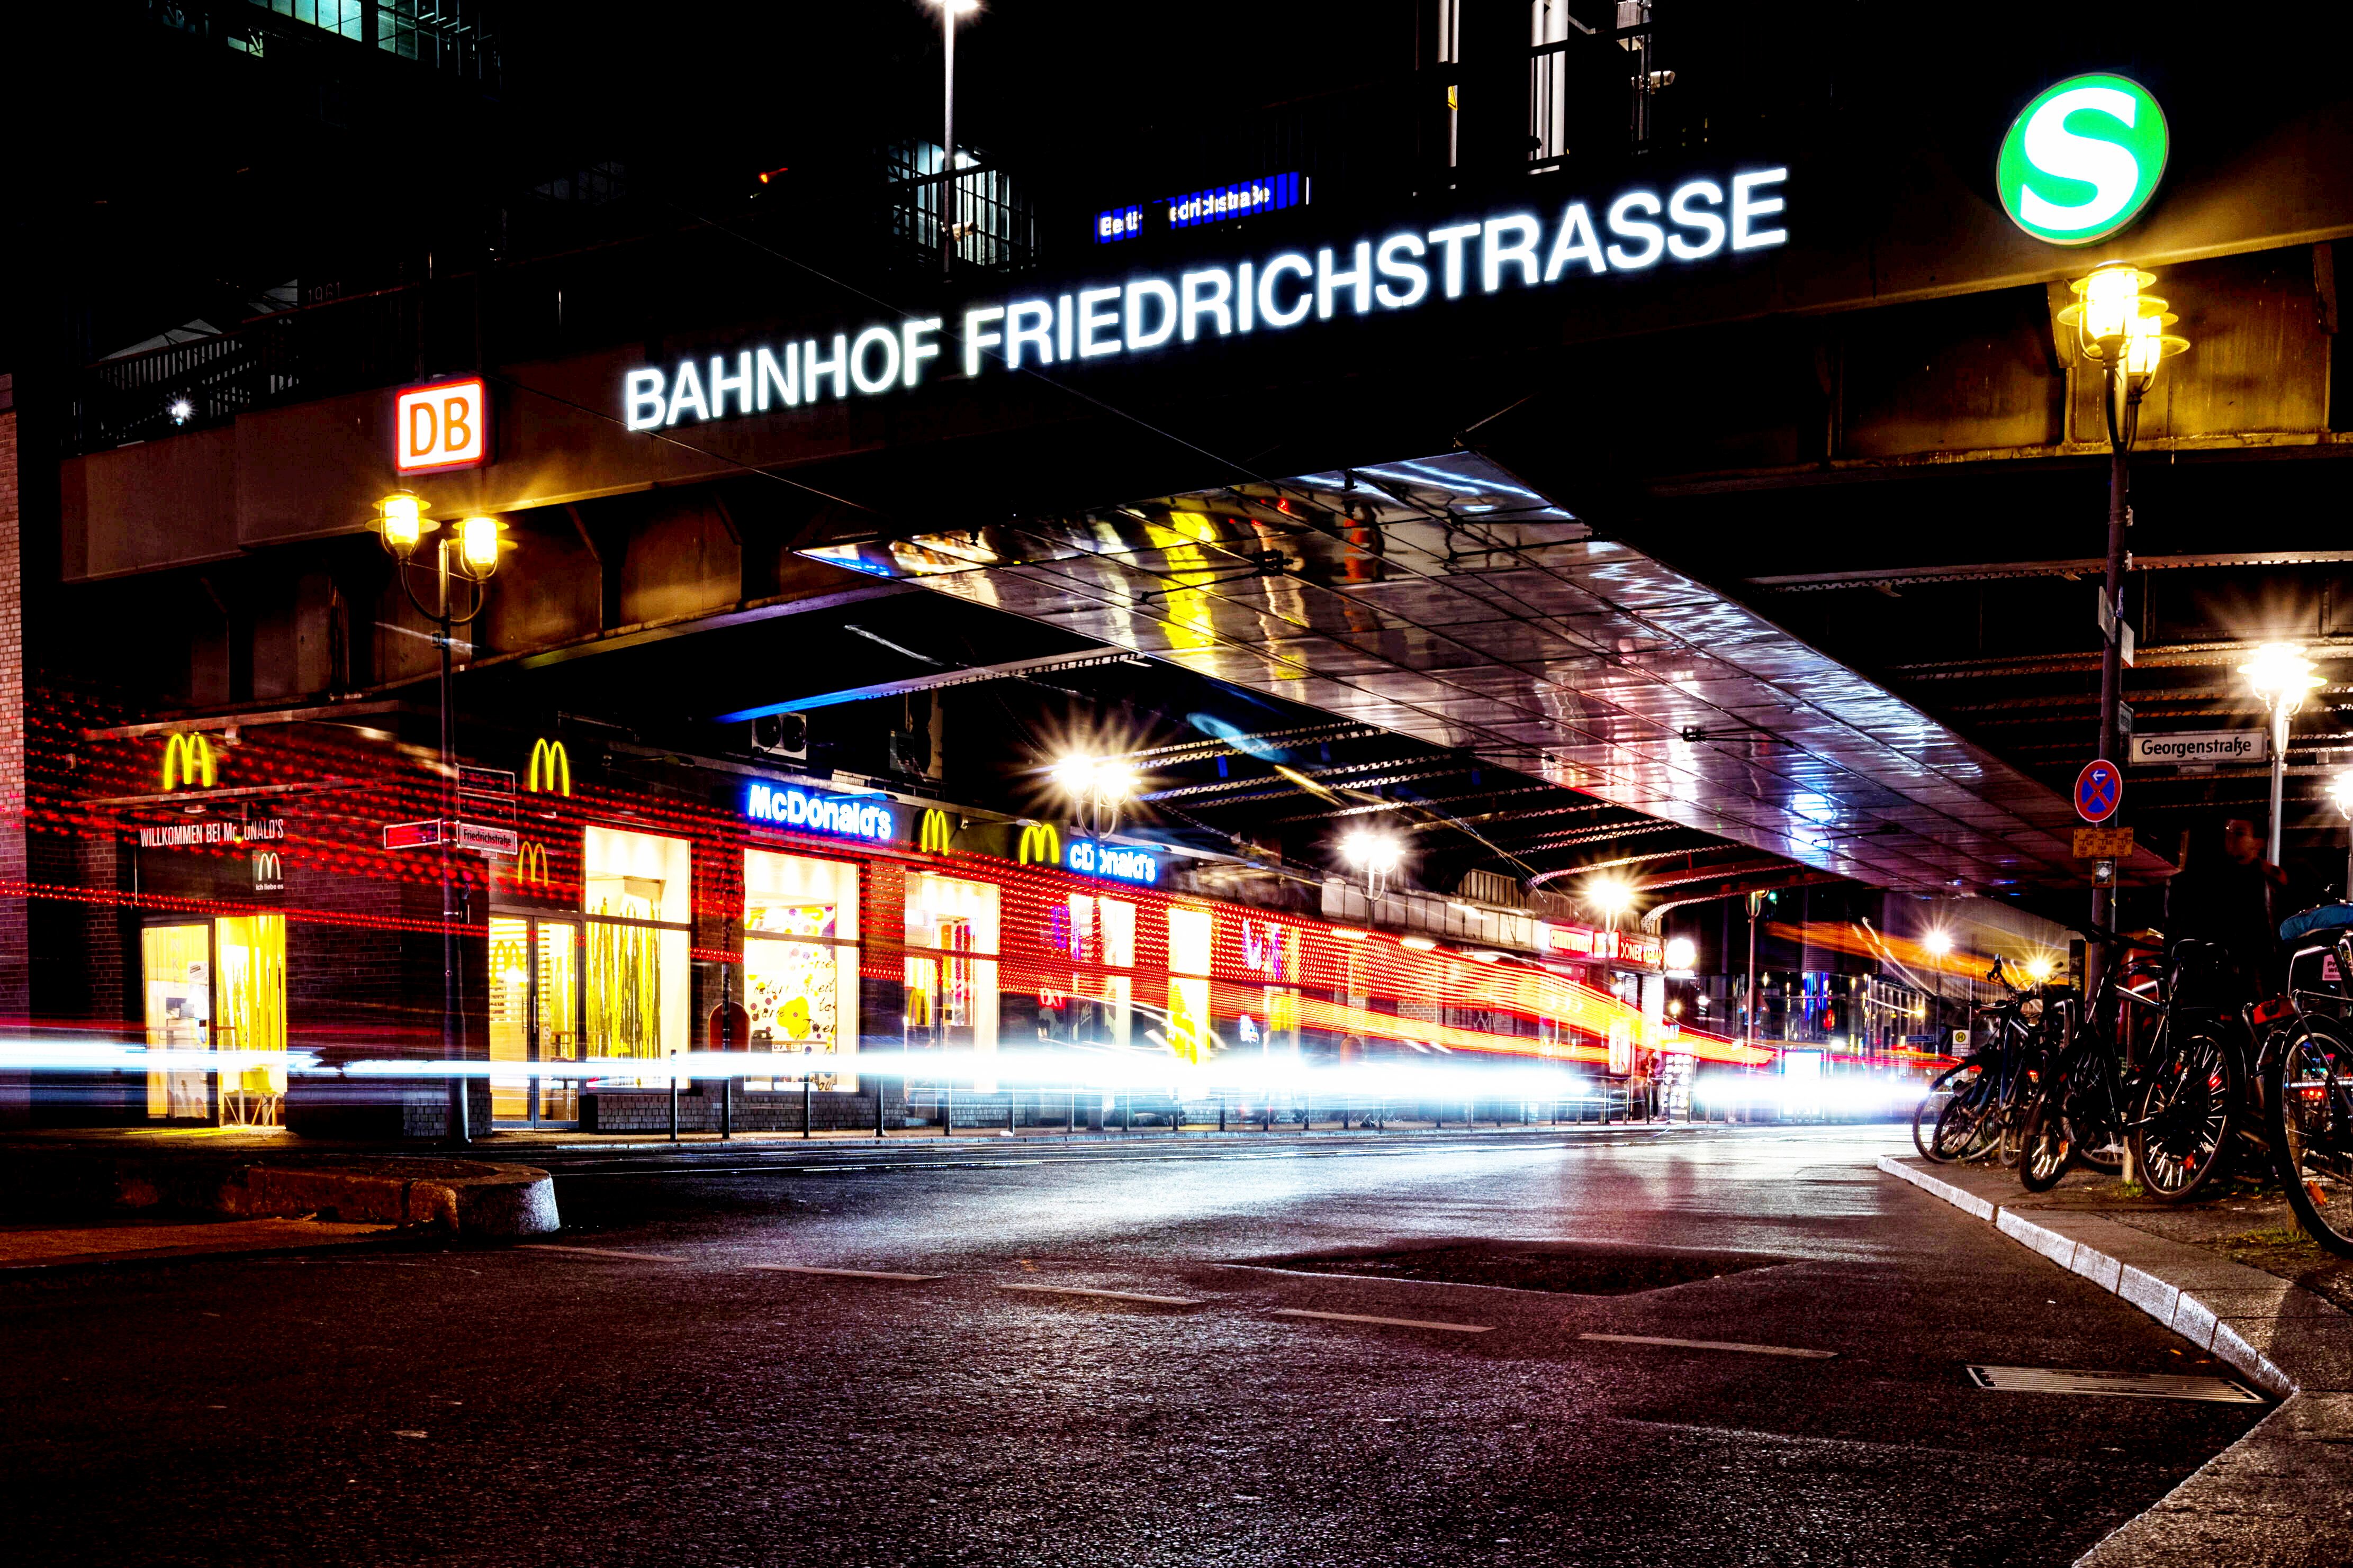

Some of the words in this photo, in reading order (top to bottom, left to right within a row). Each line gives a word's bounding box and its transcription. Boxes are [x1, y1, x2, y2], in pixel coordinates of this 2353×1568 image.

[2021, 87, 2138, 231] S
[627, 318, 942, 431] BAHNHOF
[966, 167, 1787, 376] FRIEDRICHSTRASSE
[410, 396, 471, 457] DB
[2141, 736, 2251, 758] Georgenstraße
[140, 824, 203, 847] WILLKOMMEN
[206, 823, 220, 843] BEI
[223, 819, 284, 842] McONALD'S
[749, 784, 892, 840] McDonald's
[463, 828, 512, 848] Friedrichstraße
[1620, 938, 1642, 962] DÖNER
